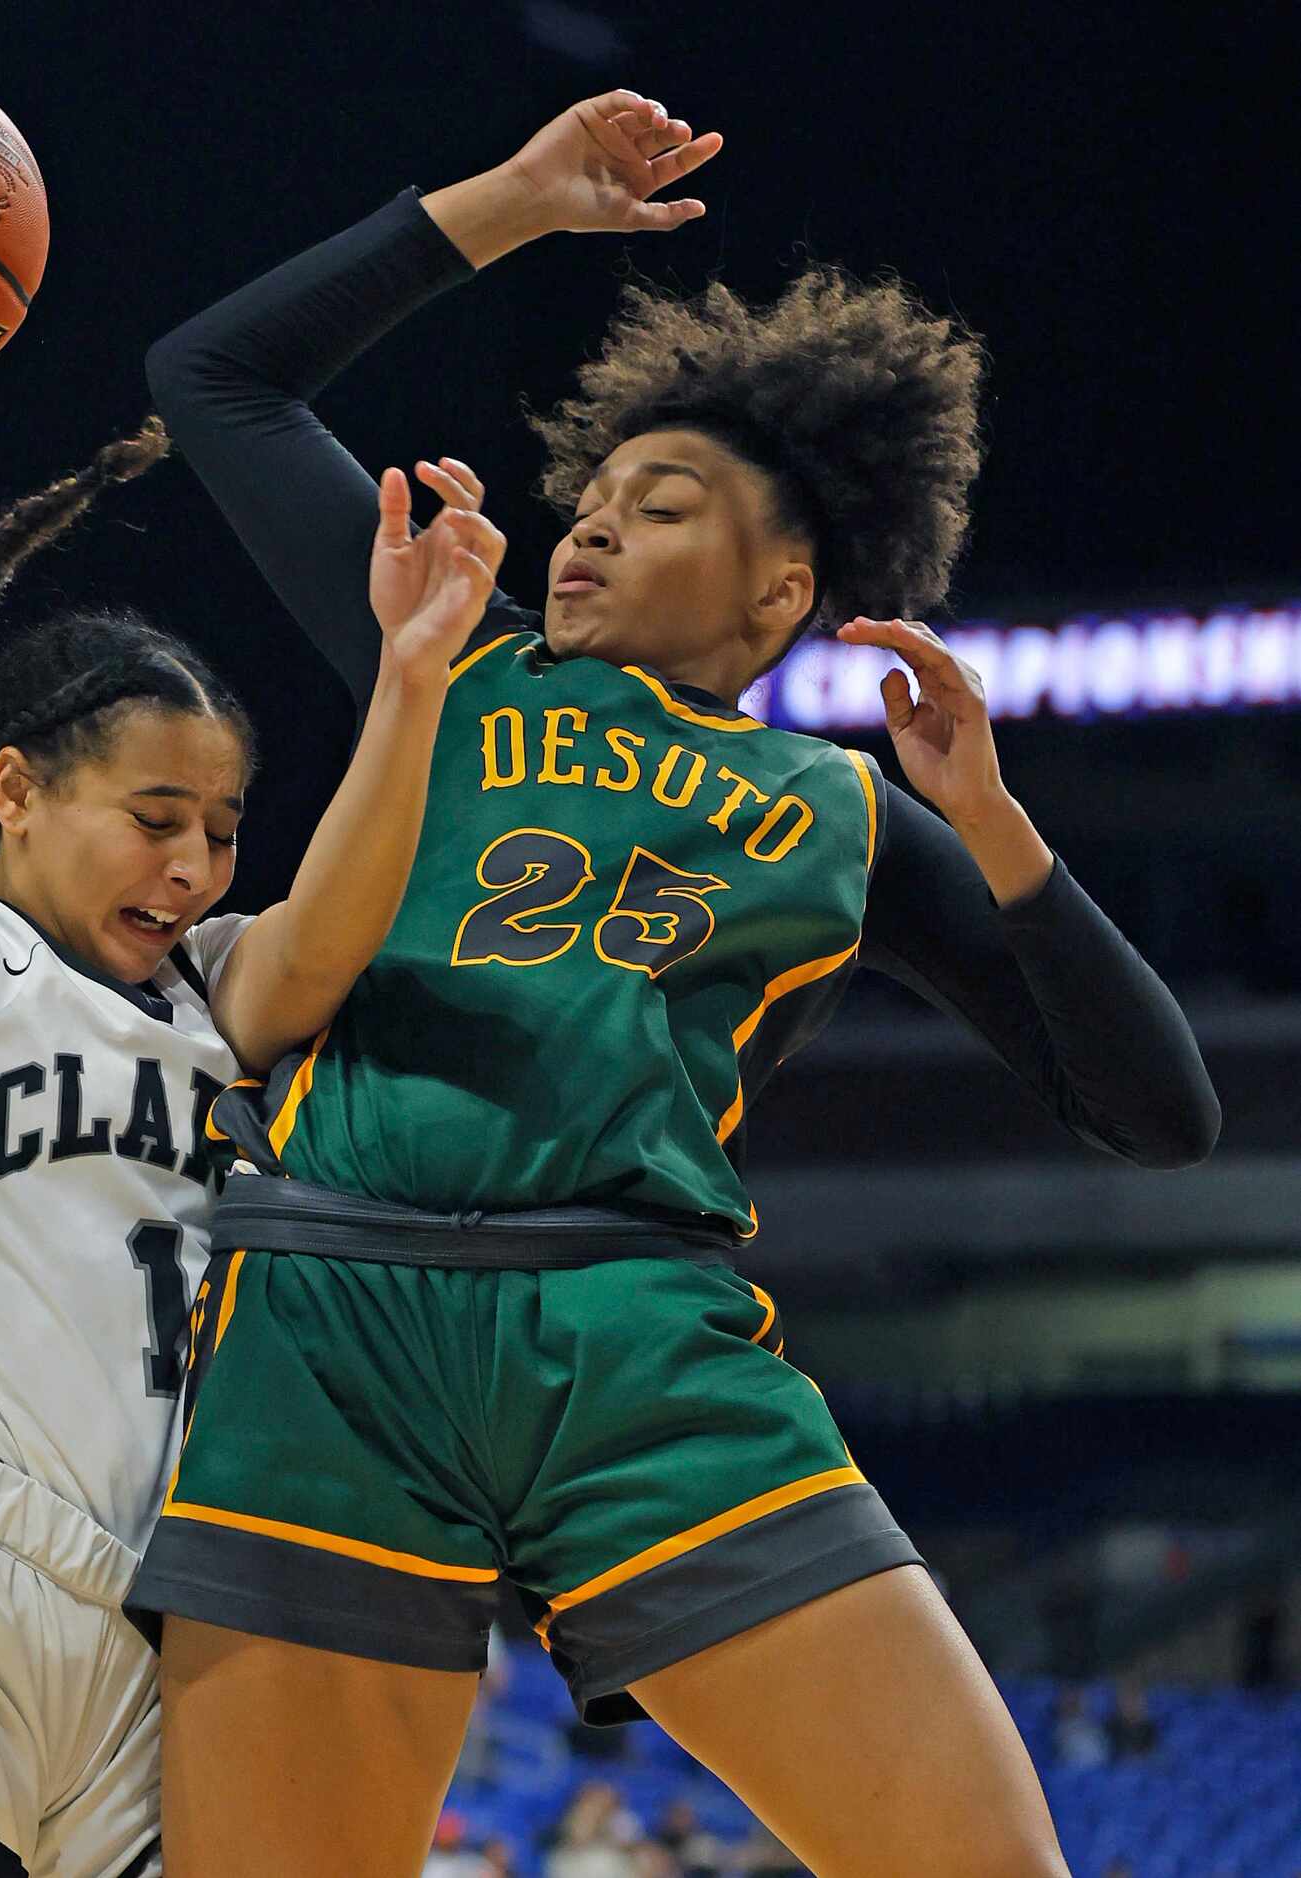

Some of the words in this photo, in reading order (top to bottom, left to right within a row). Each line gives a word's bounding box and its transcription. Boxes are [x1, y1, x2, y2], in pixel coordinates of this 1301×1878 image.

[480, 706, 815, 863] DESOTO
[450, 827, 733, 981] 25
[125, 1217, 191, 1400] 1
